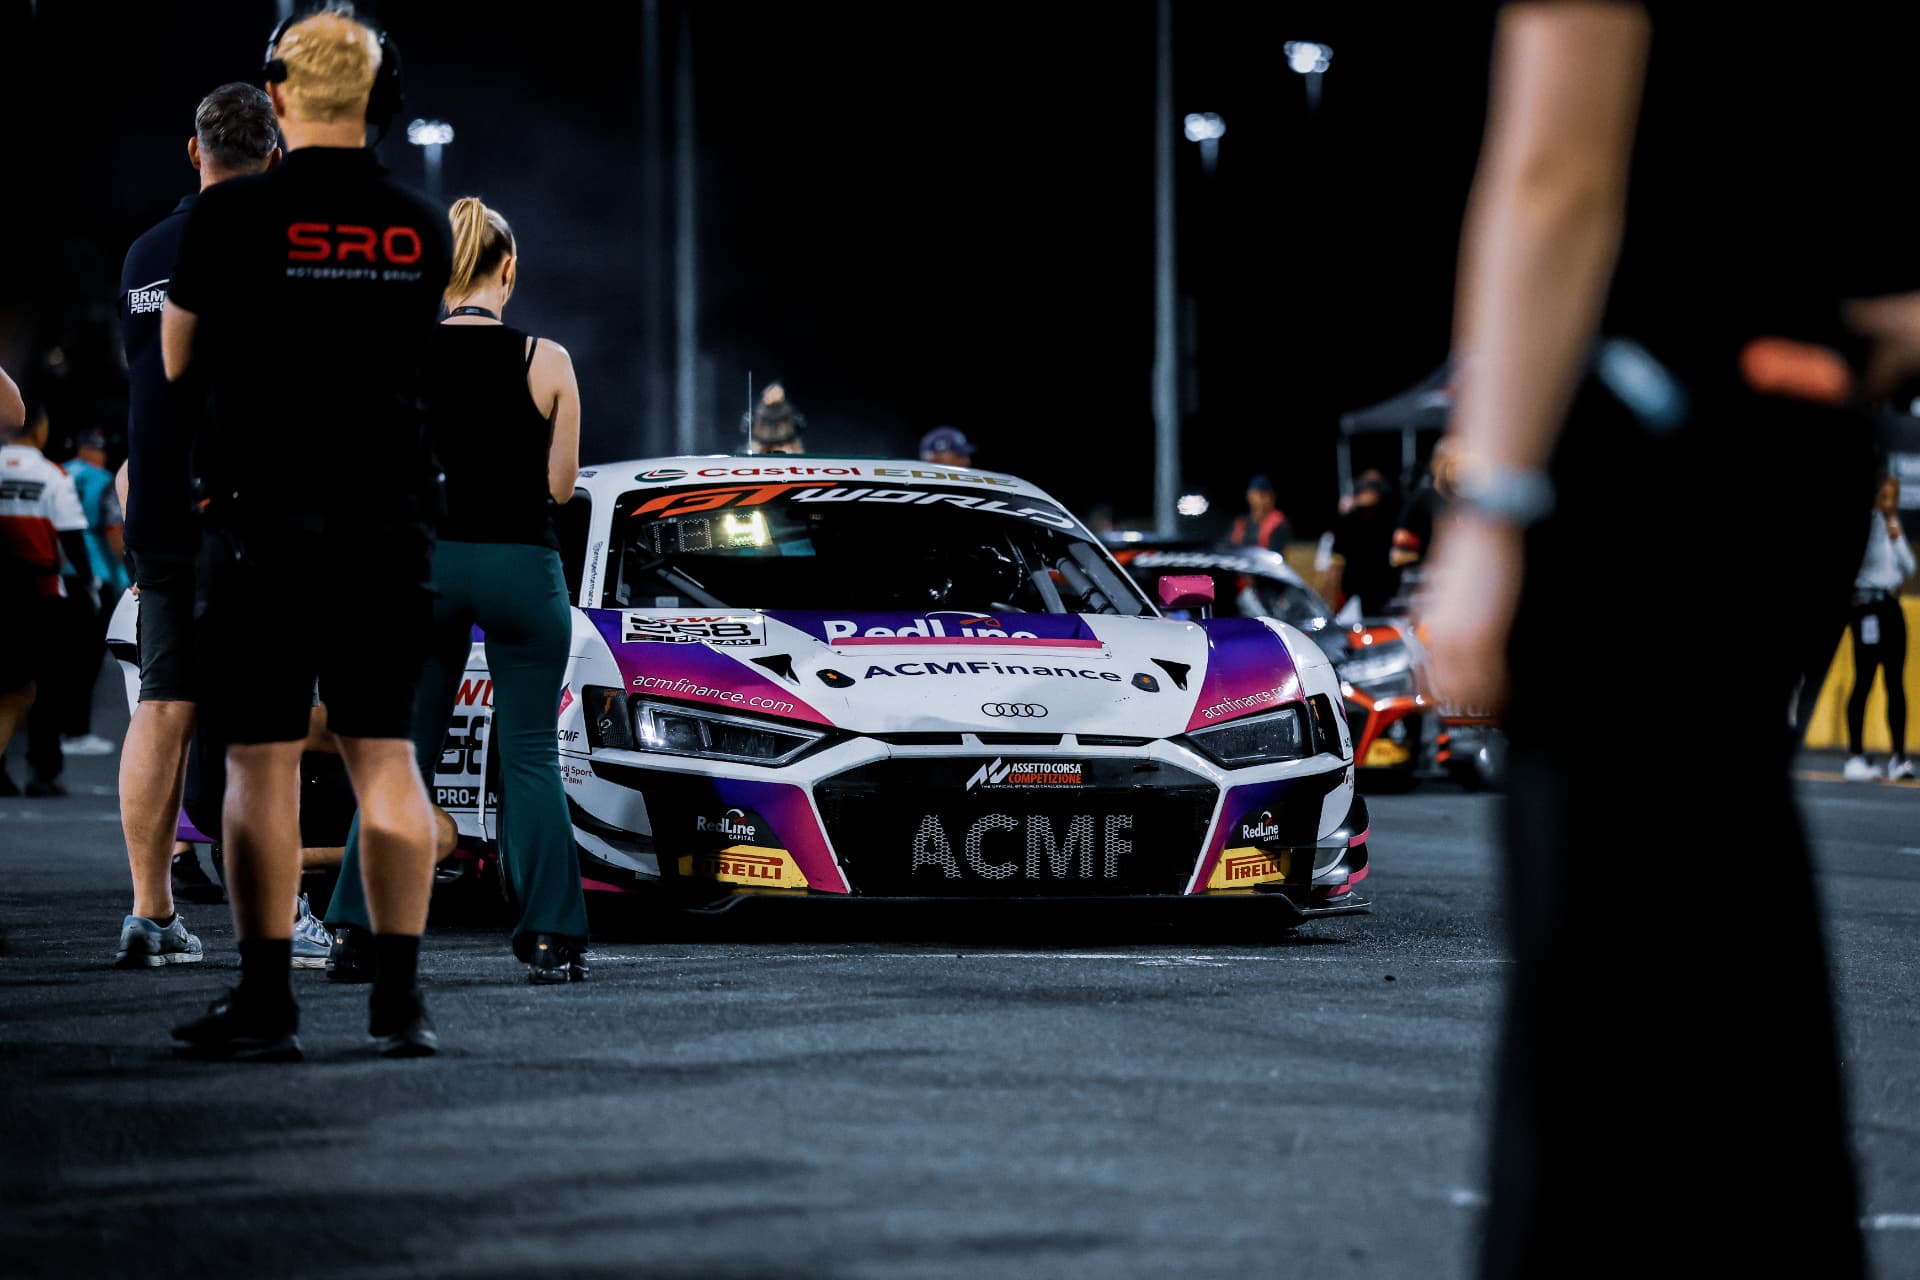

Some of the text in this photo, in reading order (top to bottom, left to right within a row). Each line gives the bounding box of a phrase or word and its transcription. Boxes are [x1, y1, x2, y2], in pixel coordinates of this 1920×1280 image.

[287, 222, 422, 264] SRO
[286, 266, 422, 282] MOTORSPORTS GROUP
[131, 290, 165, 304] BRM
[697, 466, 1018, 488] Castrol EDGE
[630, 482, 1075, 530] GT WORLD
[864, 661, 1122, 682] ACMFinance
[632, 675, 794, 713] acmfinance.com
[557, 729, 580, 743] CMF
[571, 766, 593, 778] Sport
[1012, 763, 1082, 773] ASSETTO CORSA
[1008, 773, 1082, 784] COMPETIZIONE
[436, 788, 498, 805] PRO-M
[697, 816, 756, 835] RedLine
[1242, 822, 1279, 839] RedLine
[728, 834, 755, 842] CAPITAL
[911, 813, 1133, 879] ACMF
